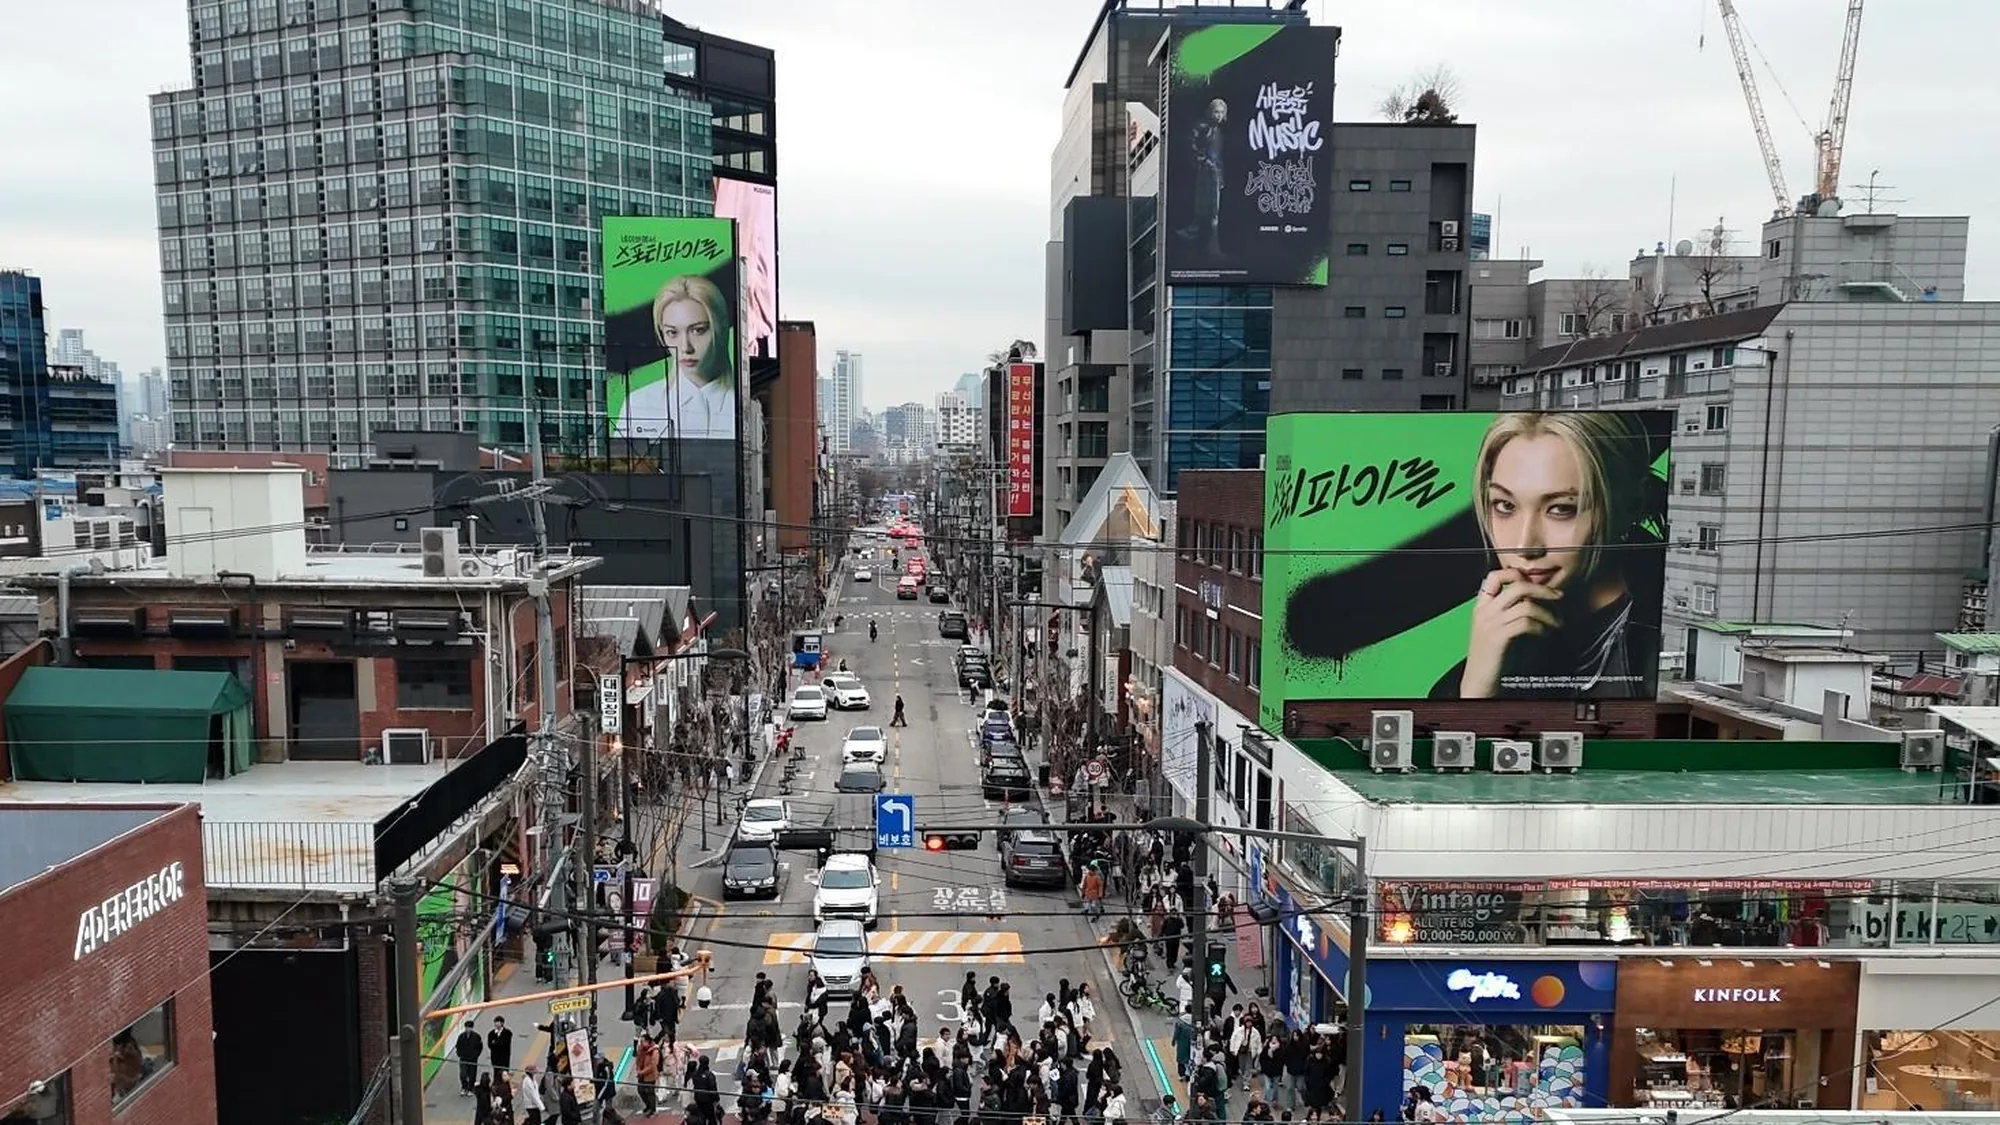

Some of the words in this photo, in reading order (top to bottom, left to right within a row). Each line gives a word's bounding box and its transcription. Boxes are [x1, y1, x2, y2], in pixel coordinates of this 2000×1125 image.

[603, 679, 617, 727] 대림창고
[1090, 764, 1100, 773] 30
[880, 833, 911, 846] 비보호
[1400, 885, 1505, 921] Vintage
[1413, 918, 1433, 928] ALL
[1440, 918, 1474, 928] ITEMS
[1694, 988, 1782, 1003] KINFOLK
[553, 1002, 571, 1011] CCTV
